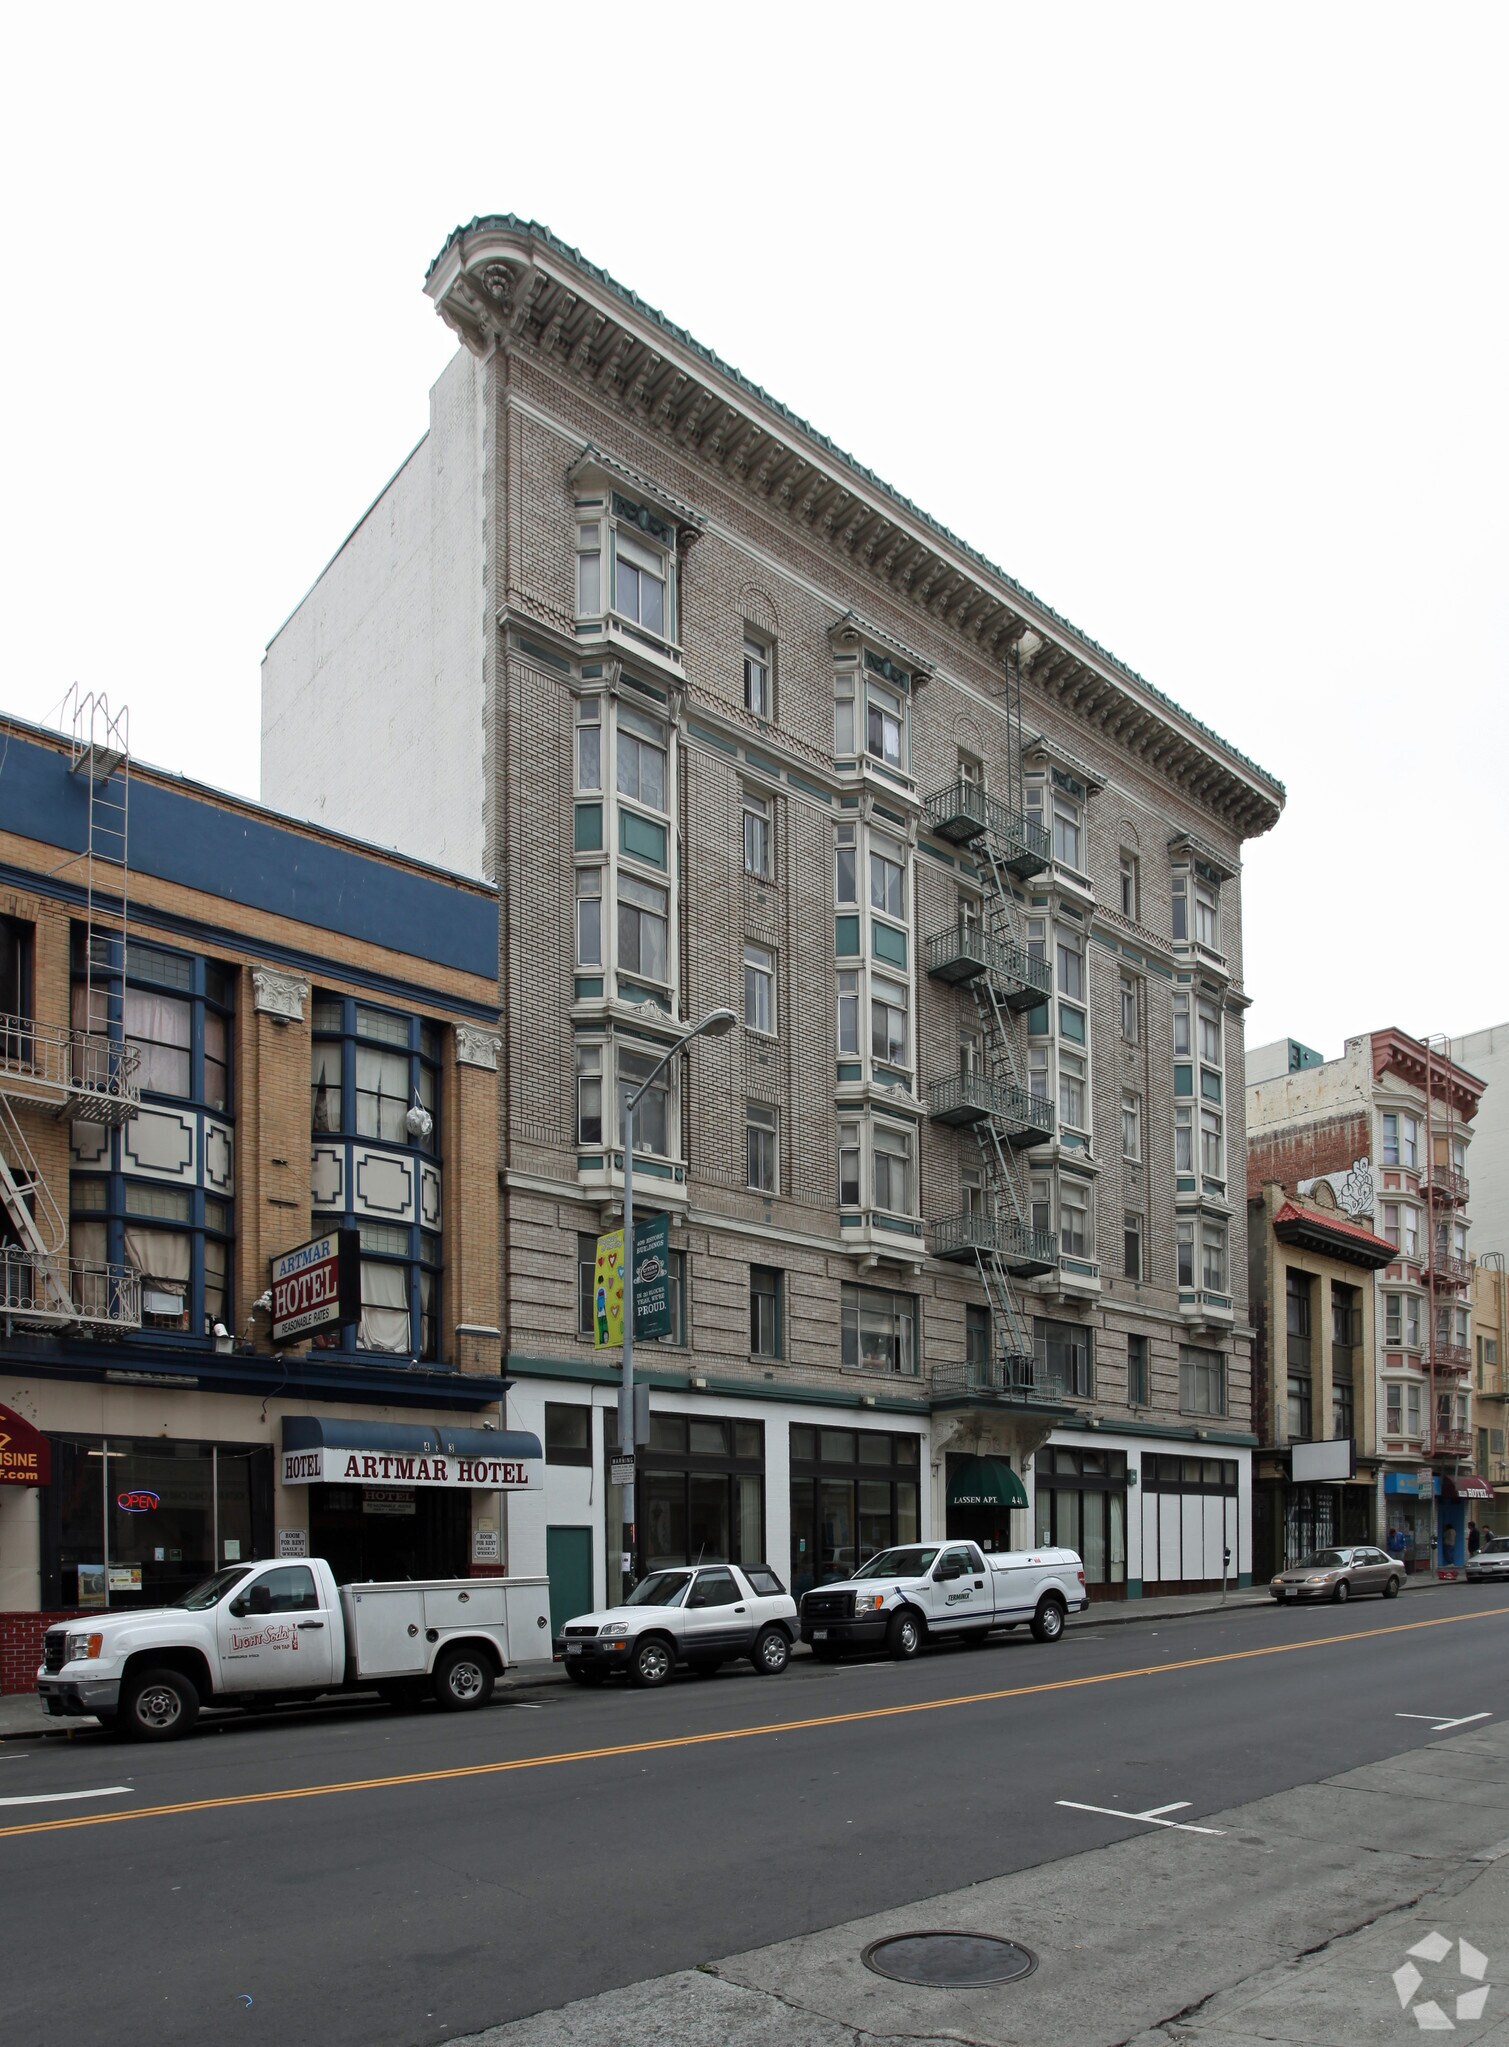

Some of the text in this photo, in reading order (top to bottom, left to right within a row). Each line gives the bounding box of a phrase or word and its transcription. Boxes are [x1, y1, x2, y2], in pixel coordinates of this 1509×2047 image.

[636, 1239, 665, 1254] BUILDINGS
[279, 1240, 330, 1276] ARTMAR
[275, 1265, 337, 1318] HOTEL
[637, 1300, 667, 1316] PROUD.
[281, 1308, 330, 1334] REASONABLE RATES
[285, 1454, 321, 1479] HOTEL
[344, 1455, 529, 1484] ARTMAR HOTEL
[117, 1493, 158, 1510] OPEN
[365, 1491, 415, 1502] HOTEL
[954, 1496, 981, 1504] LASSEN
[983, 1496, 998, 1504] APT.
[1467, 1488, 1489, 1498] HOTEL
[948, 1593, 970, 1602] TERMINIX
[262, 1625, 289, 1645] Soda
